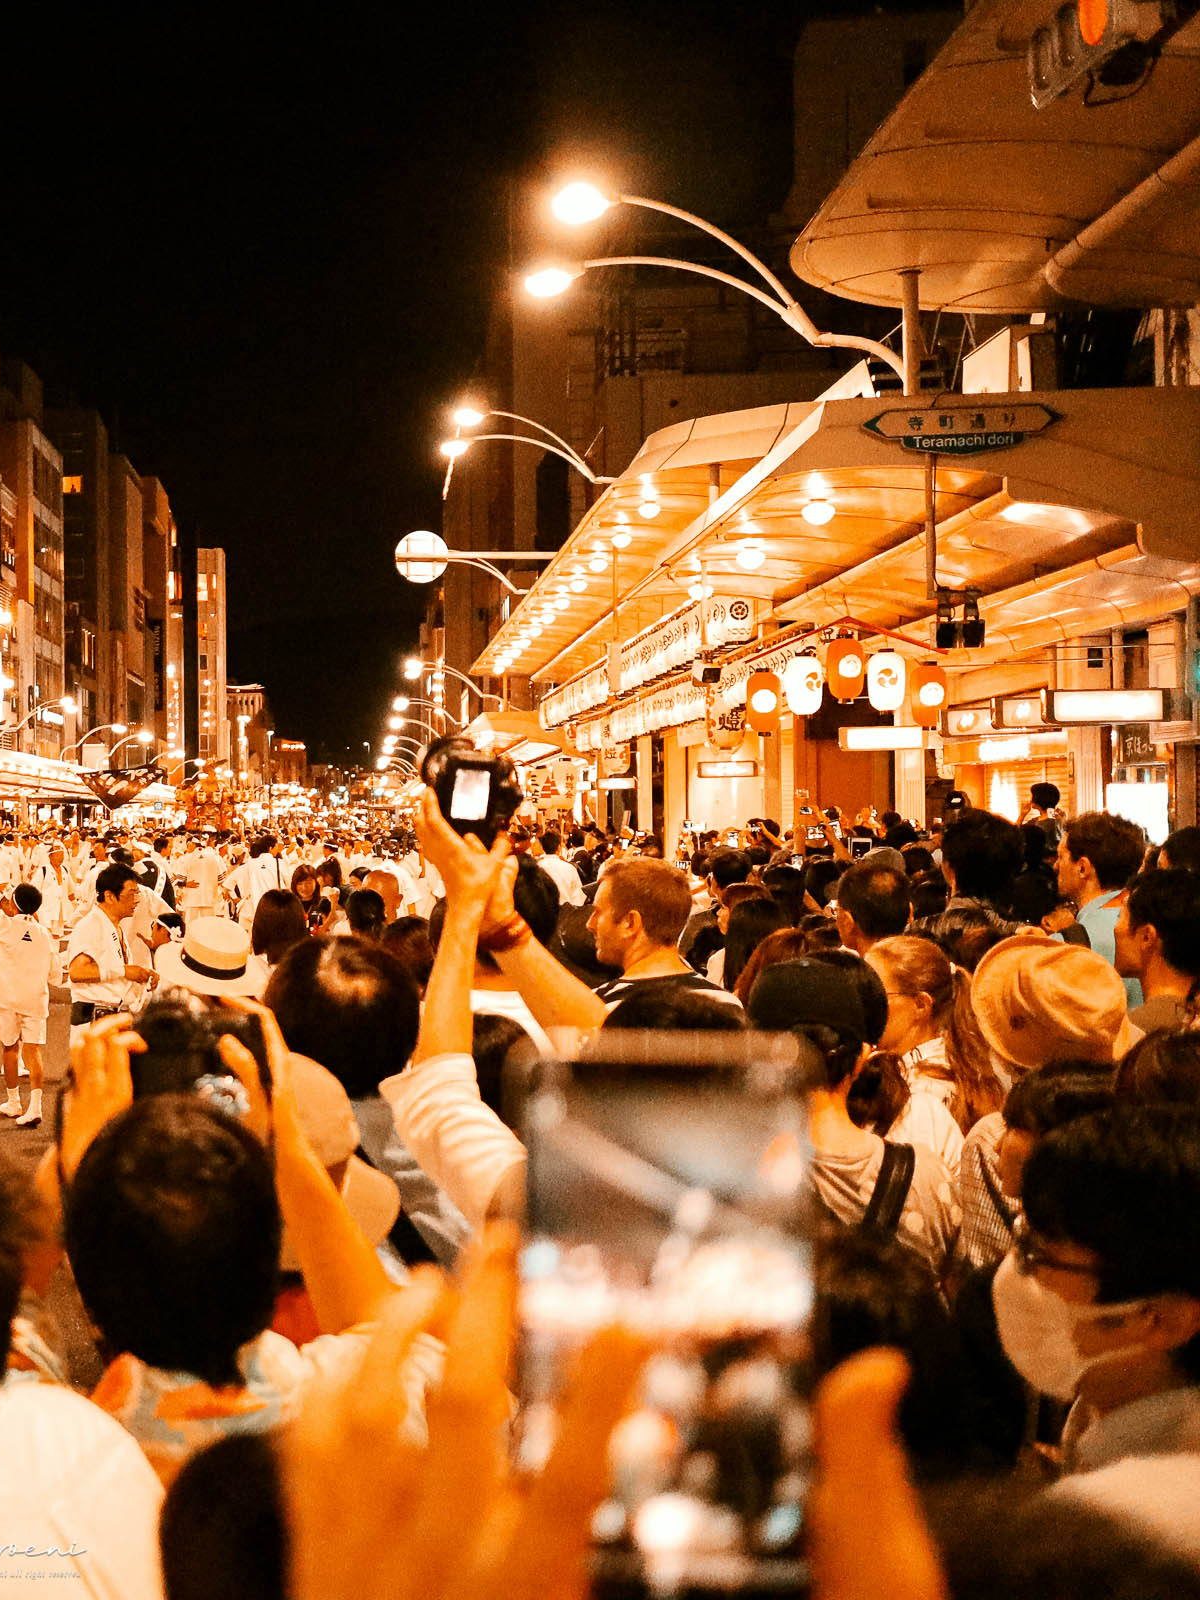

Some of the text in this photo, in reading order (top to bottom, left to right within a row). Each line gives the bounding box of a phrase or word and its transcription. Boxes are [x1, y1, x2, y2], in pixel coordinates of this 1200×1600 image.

[907, 413, 1017, 431] 寺町通り
[912, 433, 1014, 448] Teramachi dori
